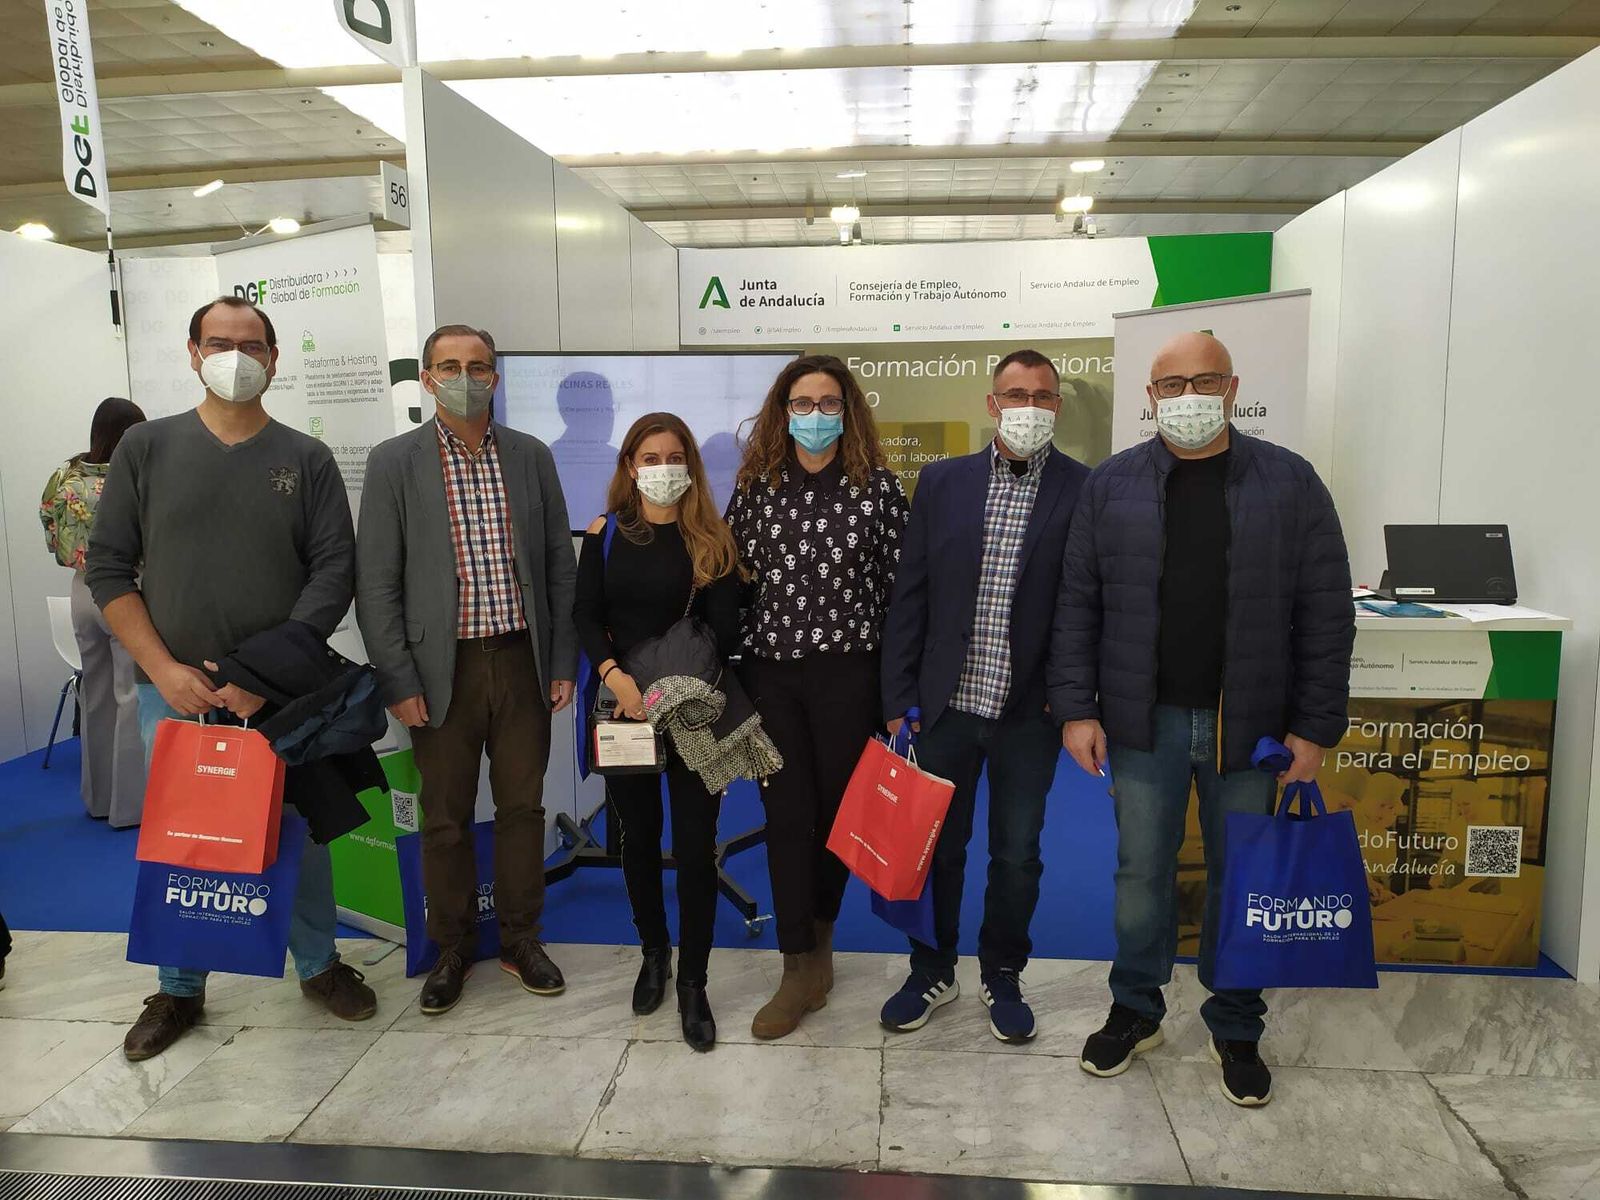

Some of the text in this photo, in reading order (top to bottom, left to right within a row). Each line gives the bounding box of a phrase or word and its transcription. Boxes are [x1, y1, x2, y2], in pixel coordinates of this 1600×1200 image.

[390, 182, 407, 208] 56
[269, 272, 323, 290] Distribuidora
[739, 279, 777, 291] Junta
[849, 279, 962, 292] Consejería de Empleo,
[1030, 278, 1140, 290] Servicio Andaluz de Empleo
[233, 280, 267, 306] DGF
[270, 281, 360, 304] Global de Formación
[739, 292, 825, 308] de Andalucía
[849, 289, 1007, 303] Formación y Trabajo Autónomo
[304, 354, 378, 369] Plataforma & Hosting
[847, 354, 976, 378] Formación
[1233, 401, 1267, 418] lucía
[910, 451, 949, 462] laboral
[1360, 662, 1395, 670] Autónomo
[1345, 716, 1484, 740] Formación
[197, 764, 236, 777] SYNERGIE
[1335, 751, 1392, 773] para
[1401, 750, 1423, 770] el
[1432, 749, 1531, 776] Empleo
[1357, 829, 1459, 850] doFuturo
[167, 873, 271, 898] FORMANDO
[165, 887, 268, 917] FUTURO
[1247, 893, 1353, 913] FORMANDO
[1246, 908, 1353, 931] FUTURO
